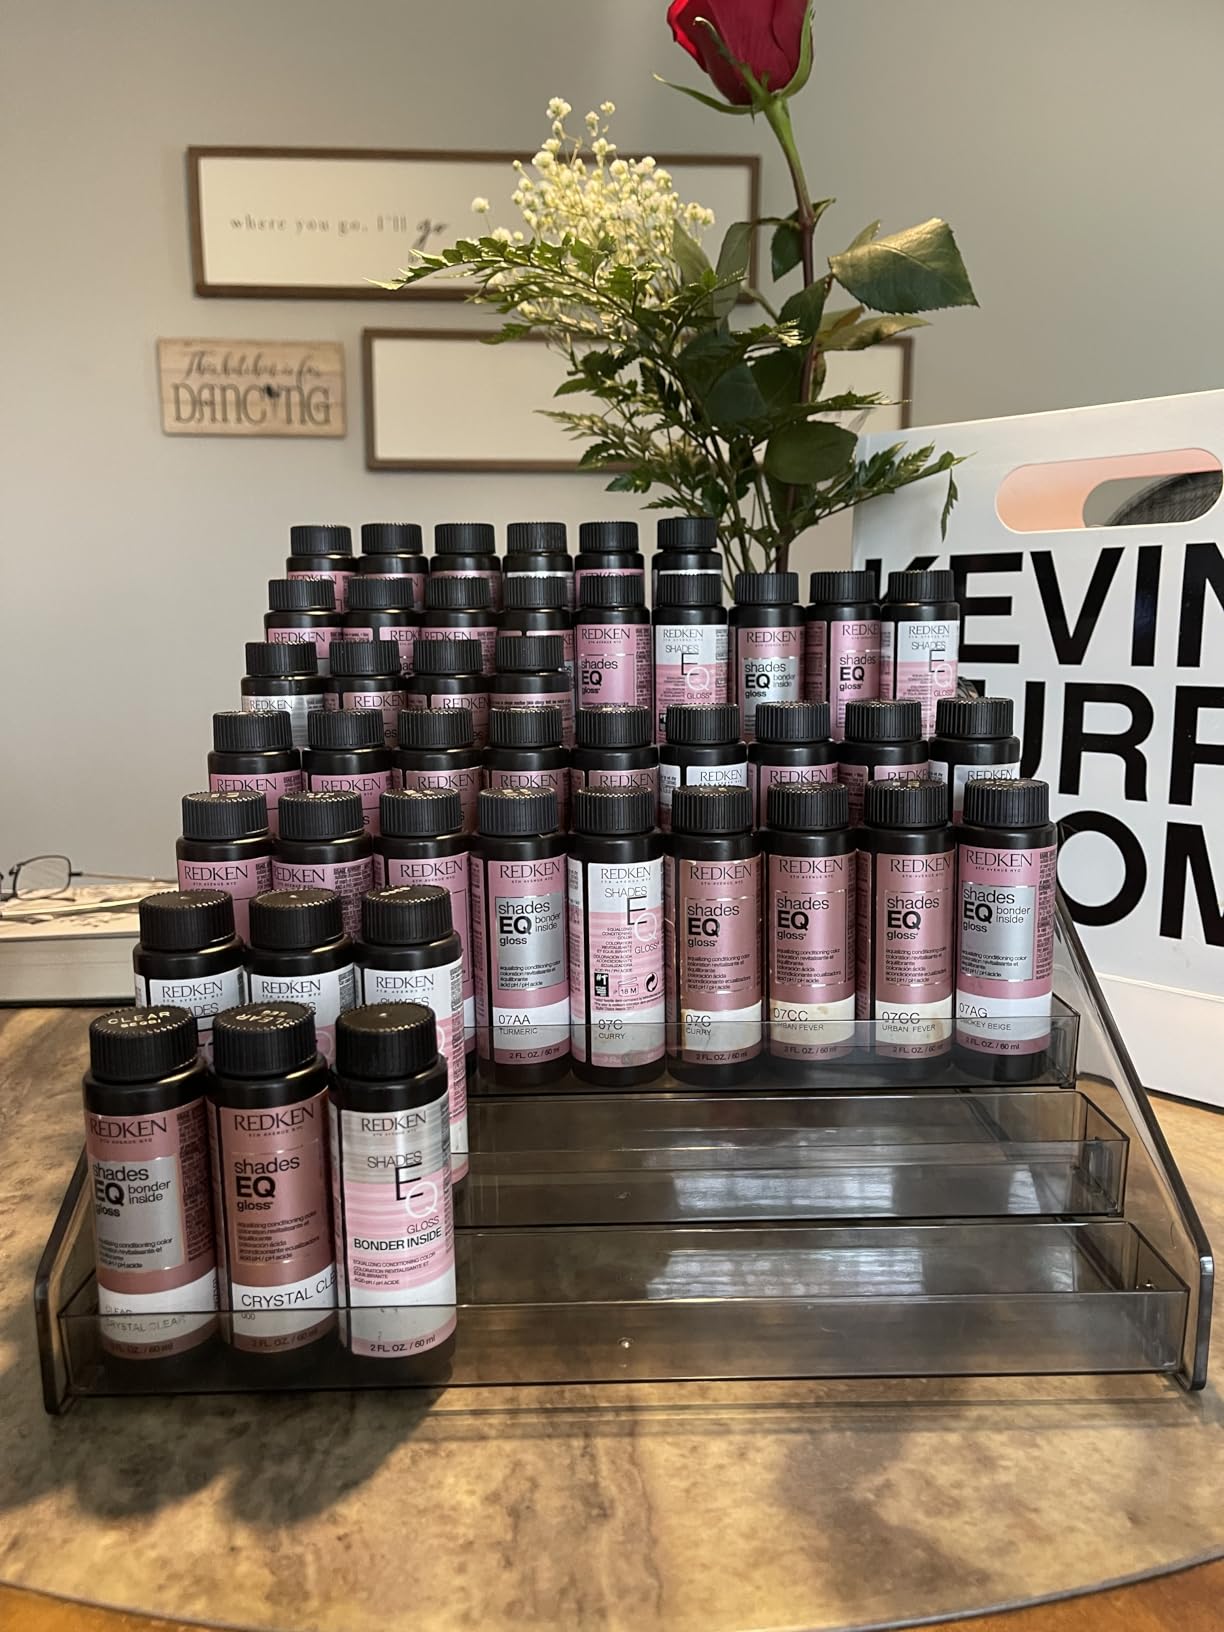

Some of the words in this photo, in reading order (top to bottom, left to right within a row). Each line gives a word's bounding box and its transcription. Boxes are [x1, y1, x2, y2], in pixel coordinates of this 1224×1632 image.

[296, 218, 329, 236] you
[273, 631, 325, 643] REDKEN
[581, 628, 630, 640] REDKEN
[663, 628, 704, 638] REDKEN
[746, 631, 797, 643] REDKEN
[909, 625, 950, 635] REDKEN
[665, 644, 699, 653] SHADES
[911, 641, 946, 650] SHADES
[581, 659, 618, 670] shades
[839, 652, 877, 665] shades
[745, 660, 786, 672] shades
[582, 671, 602, 686] EQ
[745, 674, 770, 689] EQ
[840, 667, 865, 682] EQ
[745, 690, 767, 698] gloss
[839, 683, 861, 691] gloss
[687, 692, 710, 700] GLOSS
[251, 700, 292, 710] REDKEN
[418, 773, 475, 790] REDKEN
[501, 773, 558, 787] REDKEN
[600, 772, 654, 787] REDKEN
[700, 769, 743, 782] REDKEN
[770, 767, 828, 783] REDKEN
[968, 769, 1013, 780] REDKEN
[217, 778, 277, 792] REDKEN
[322, 778, 381, 792] REDKEN
[890, 857, 950, 873] REDKEN
[966, 850, 1032, 867] REDKEN
[184, 865, 248, 881] REDKEN
[401, 860, 463, 878] REDKEN
[500, 859, 560, 878] REDKEN
[601, 866, 650, 880] REDKEN
[690, 864, 751, 880] REDKEN
[779, 858, 843, 874] REDKEN
[605, 885, 647, 898] SHADES
[963, 887, 1015, 904] shades
[498, 901, 550, 914] shades
[688, 903, 740, 916] shades
[777, 896, 829, 910] shades
[887, 896, 940, 909] shades
[887, 910, 921, 930] EQ
[963, 902, 993, 924] EQ
[996, 906, 1030, 915] bonder
[500, 916, 532, 935] EQ
[535, 912, 560, 923] bonder
[688, 917, 720, 937] EQ
[777, 910, 809, 931] EQ
[963, 921, 987, 933] gloss
[996, 914, 1024, 924] inside
[500, 935, 528, 946] gloss
[535, 921, 558, 932] inside
[777, 930, 803, 940] gloss
[887, 931, 915, 940] gloss
[634, 942, 658, 954] GLOSS
[688, 937, 715, 947] gloss
[262, 978, 321, 995] REDKEN
[376, 974, 434, 989] REDKEN
[162, 980, 222, 998] REDKEN
[620, 987, 629, 995] 18
[630, 987, 637, 995] M
[774, 1007, 808, 1021] 07CC
[959, 1002, 988, 1018] 07AG
[108, 1011, 170, 1024] CLEAR
[498, 1014, 531, 1025] 07AA
[499, 1027, 538, 1036] TURMERIC
[686, 1028, 711, 1036] CURRY
[882, 1024, 909, 1032] URBAN
[912, 1024, 936, 1032] FEVER
[988, 1023, 1011, 1031] BEIGE
[598, 1032, 625, 1040] CURRY
[234, 1103, 314, 1132] REDKEN
[361, 1111, 427, 1132] REDKEN
[90, 1117, 167, 1138] REDKEN
[234, 1156, 300, 1174] shades
[367, 1150, 423, 1169] SHADES
[93, 1163, 149, 1182] shades
[95, 1182, 124, 1206] EQ
[128, 1180, 171, 1194] bonder
[236, 1176, 275, 1198] EQ
[96, 1205, 120, 1217] gloss
[128, 1192, 163, 1205] inside
[236, 1201, 270, 1213] gloss
[407, 1216, 440, 1235] GLOSS
[354, 1238, 405, 1251] BONDER
[407, 1227, 442, 1248] INSIDE
[241, 1287, 313, 1308] CRYSTAL
[415, 1340, 425, 1348] 60
[425, 1334, 435, 1345] ml
